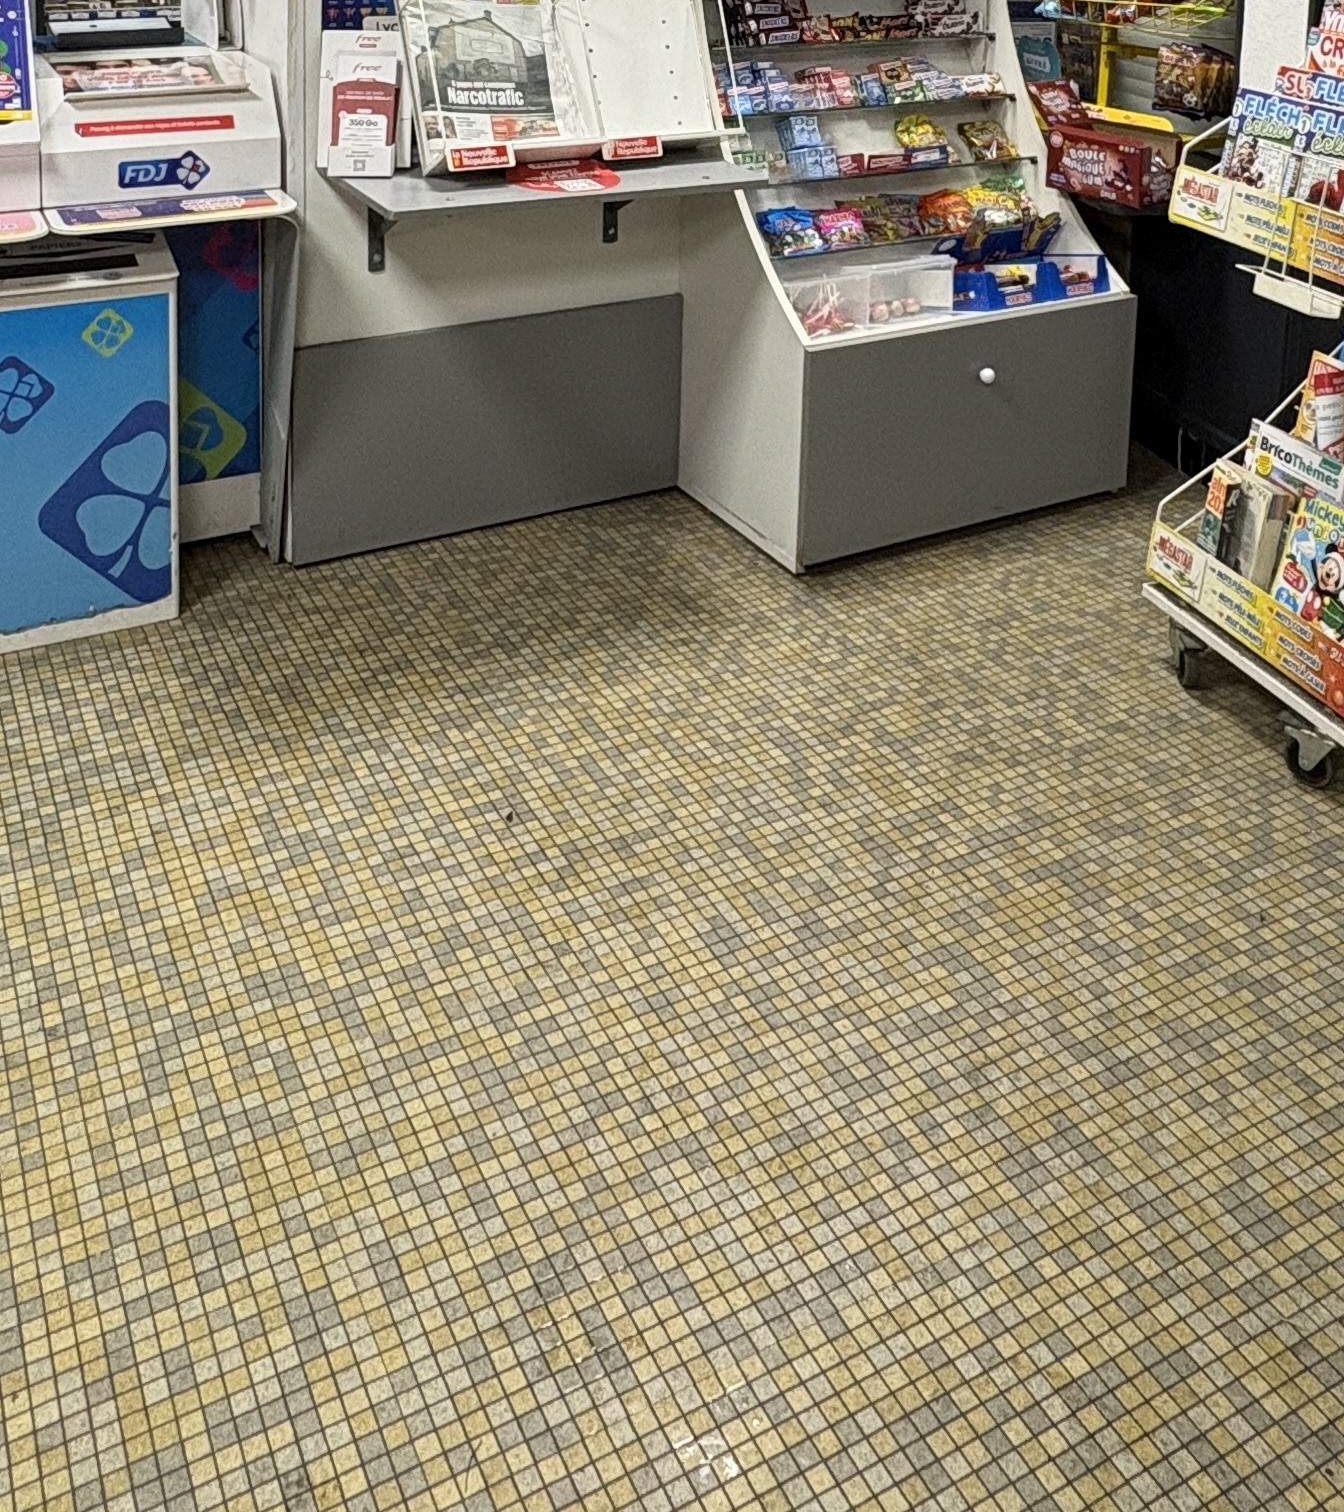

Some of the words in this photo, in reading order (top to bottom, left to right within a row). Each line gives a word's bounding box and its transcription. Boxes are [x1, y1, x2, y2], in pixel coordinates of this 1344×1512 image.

[355, 35, 382, 45] free
[352, 63, 383, 73] free
[447, 87, 524, 107] Narcotrafic
[1243, 117, 1293, 140] éclair
[1069, 148, 1105, 160] BOULE
[124, 164, 168, 184] FDJ
[1082, 174, 1103, 186] GUM
[1260, 436, 1340, 490] BricoThèmes
